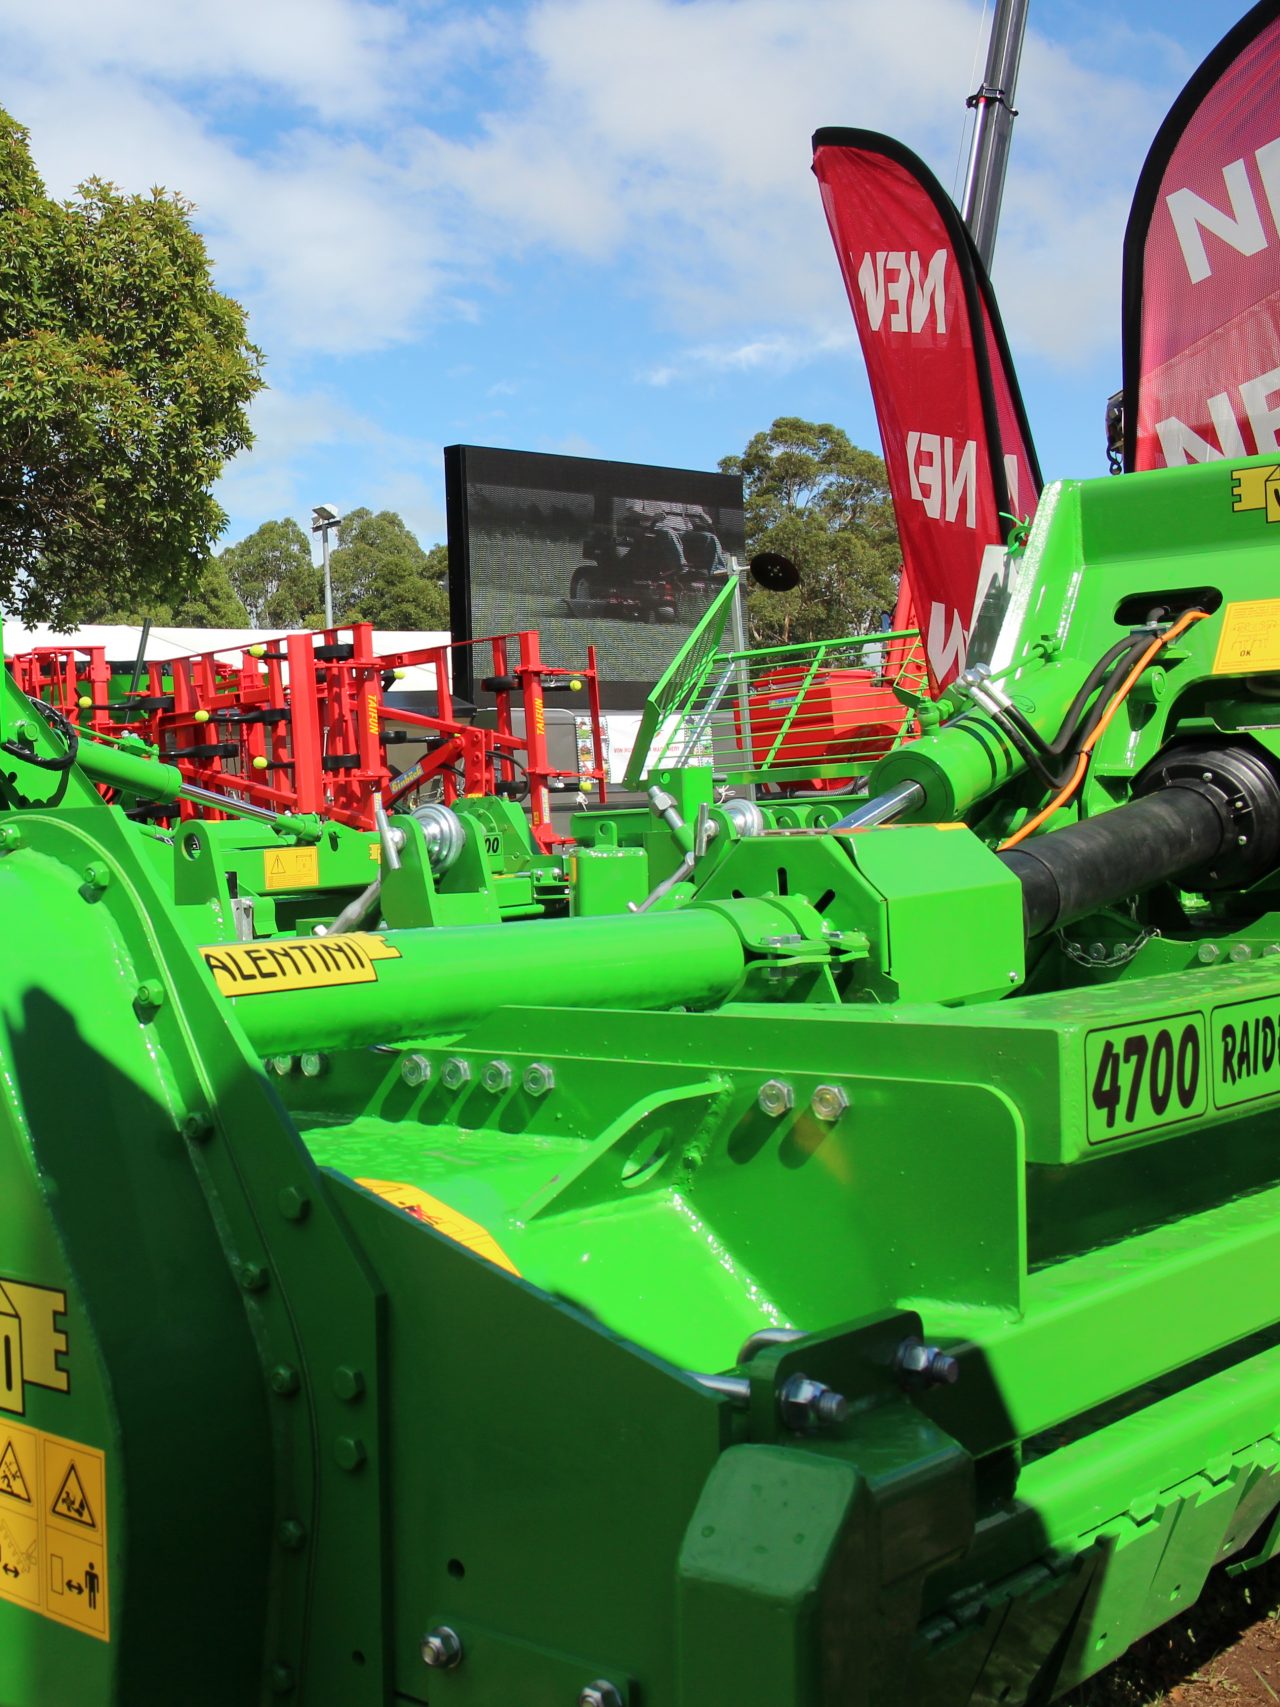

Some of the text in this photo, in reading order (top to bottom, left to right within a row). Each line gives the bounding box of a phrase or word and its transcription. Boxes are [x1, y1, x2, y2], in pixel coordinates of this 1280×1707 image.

[367, 694, 379, 735] TAIFUN
[534, 697, 545, 735] TAIFUN
[485, 837, 500, 853] 00
[205, 941, 366, 982] ALENTINI
[1092, 1014, 1280, 1129] 4700 RAID
